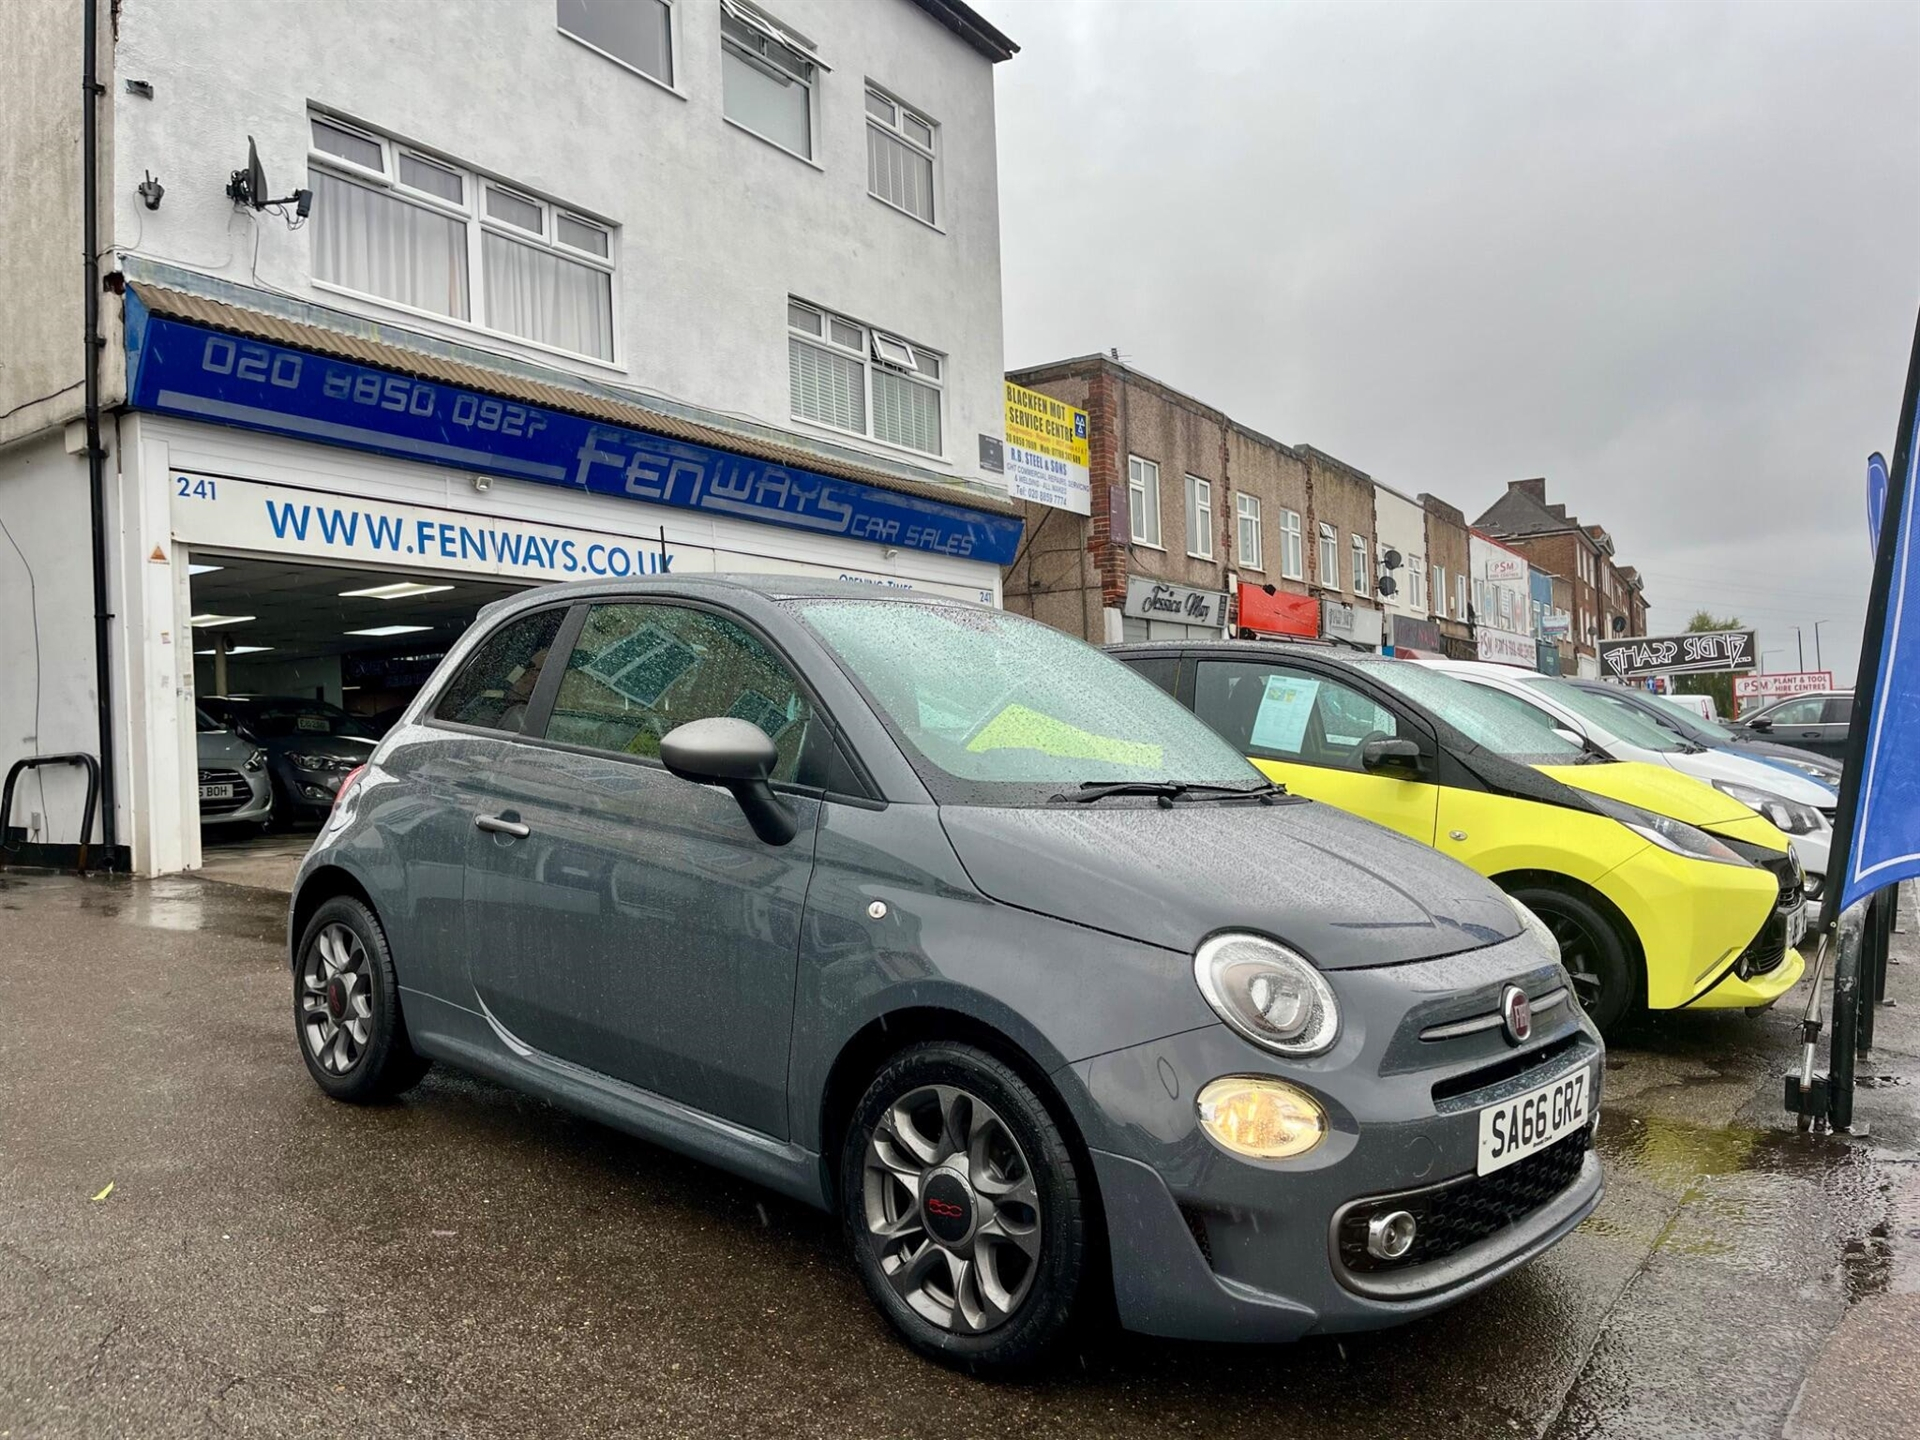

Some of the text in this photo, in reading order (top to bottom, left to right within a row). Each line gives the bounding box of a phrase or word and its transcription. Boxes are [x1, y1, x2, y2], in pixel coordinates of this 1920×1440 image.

[202, 336, 303, 389] 020
[1006, 385, 1066, 421] BLACKFEN MOT
[1009, 407, 1043, 433] SERVICE
[1046, 419, 1074, 443] CENTRE
[1025, 452, 1044, 470] STEEL
[1050, 460, 1067, 476] SONS
[176, 476, 217, 501] 241
[266, 499, 674, 575] WWW.FENWAYS.CO.UK
[850, 514, 899, 542] CAR
[905, 529, 974, 556] SALES
[1494, 561, 1514, 572] PSM
[979, 591, 992, 603] 241
[1185, 593, 1210, 622] May
[1603, 643, 1678, 675] SHARP
[1744, 680, 1768, 692] PSM
[1775, 684, 1791, 692] HIRE
[206, 786, 227, 797] BOH
[1491, 1074, 1585, 1159] SA66 GRZ
